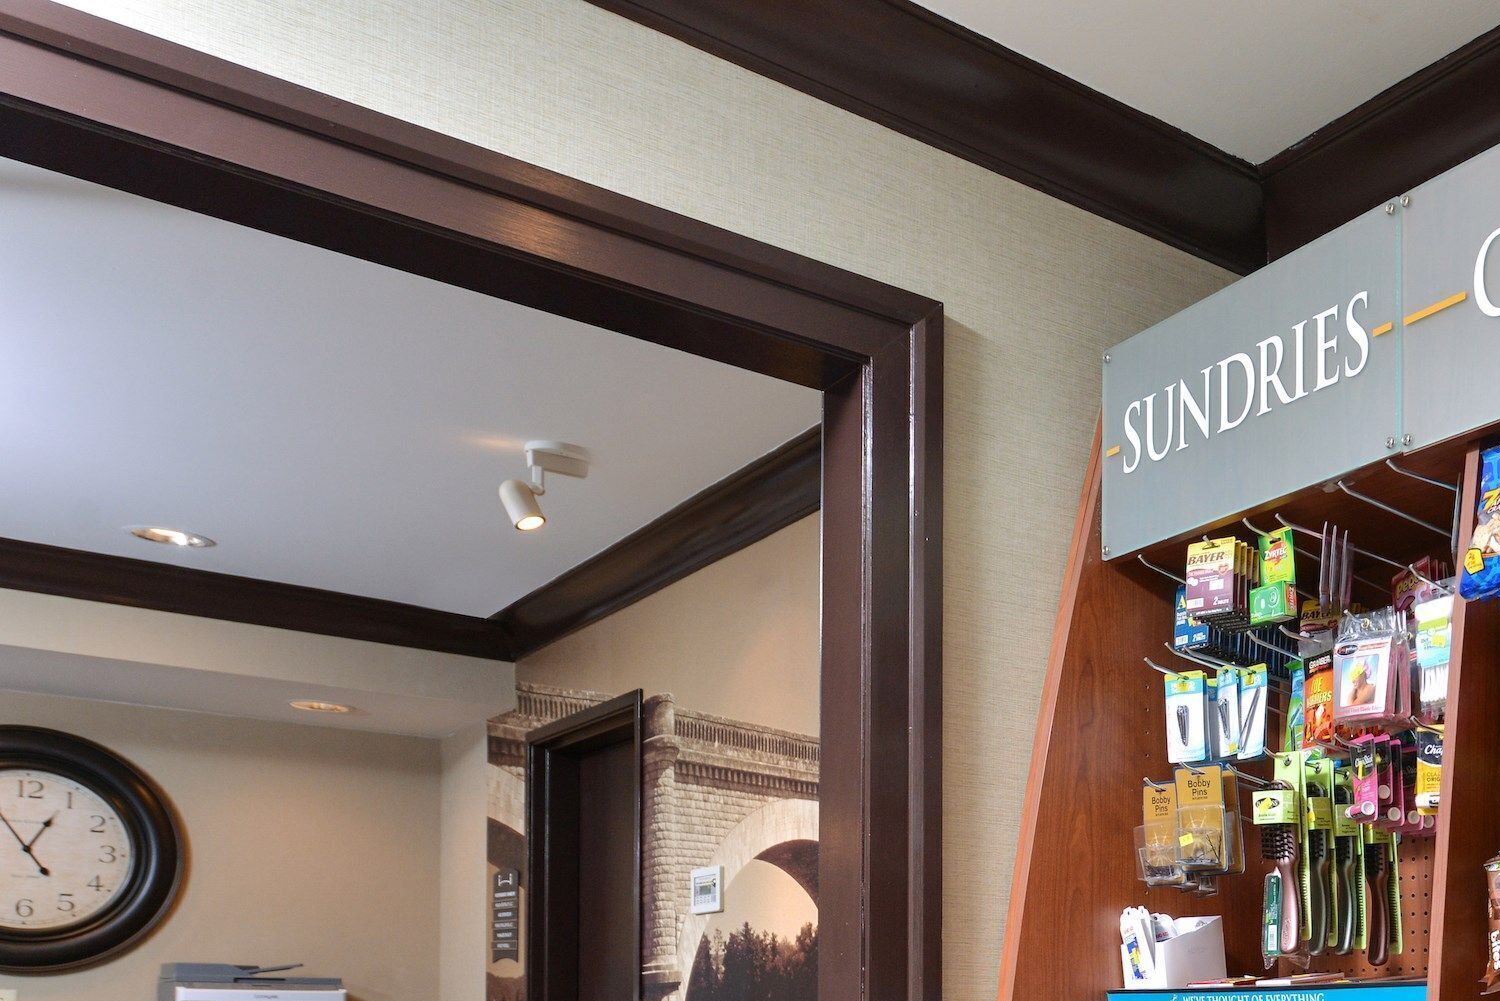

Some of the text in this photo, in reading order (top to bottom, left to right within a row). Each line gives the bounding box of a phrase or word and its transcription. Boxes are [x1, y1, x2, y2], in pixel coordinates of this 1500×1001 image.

[1121, 290, 1370, 474] SUNDRIES
[1188, 551, 1225, 565] BAYER
[17, 779, 44, 799] 12
[1188, 779, 1211, 788] Bobby
[1192, 788, 1208, 797] Pins
[66, 791, 74, 809] 1
[1152, 796, 1171, 805] Bobby
[1155, 805, 1168, 813] Pins
[90, 815, 106, 833] 2
[99, 845, 117, 863] 3
[87, 875, 104, 892] 4
[15, 899, 34, 917] 6
[56, 893, 76, 912] 5
